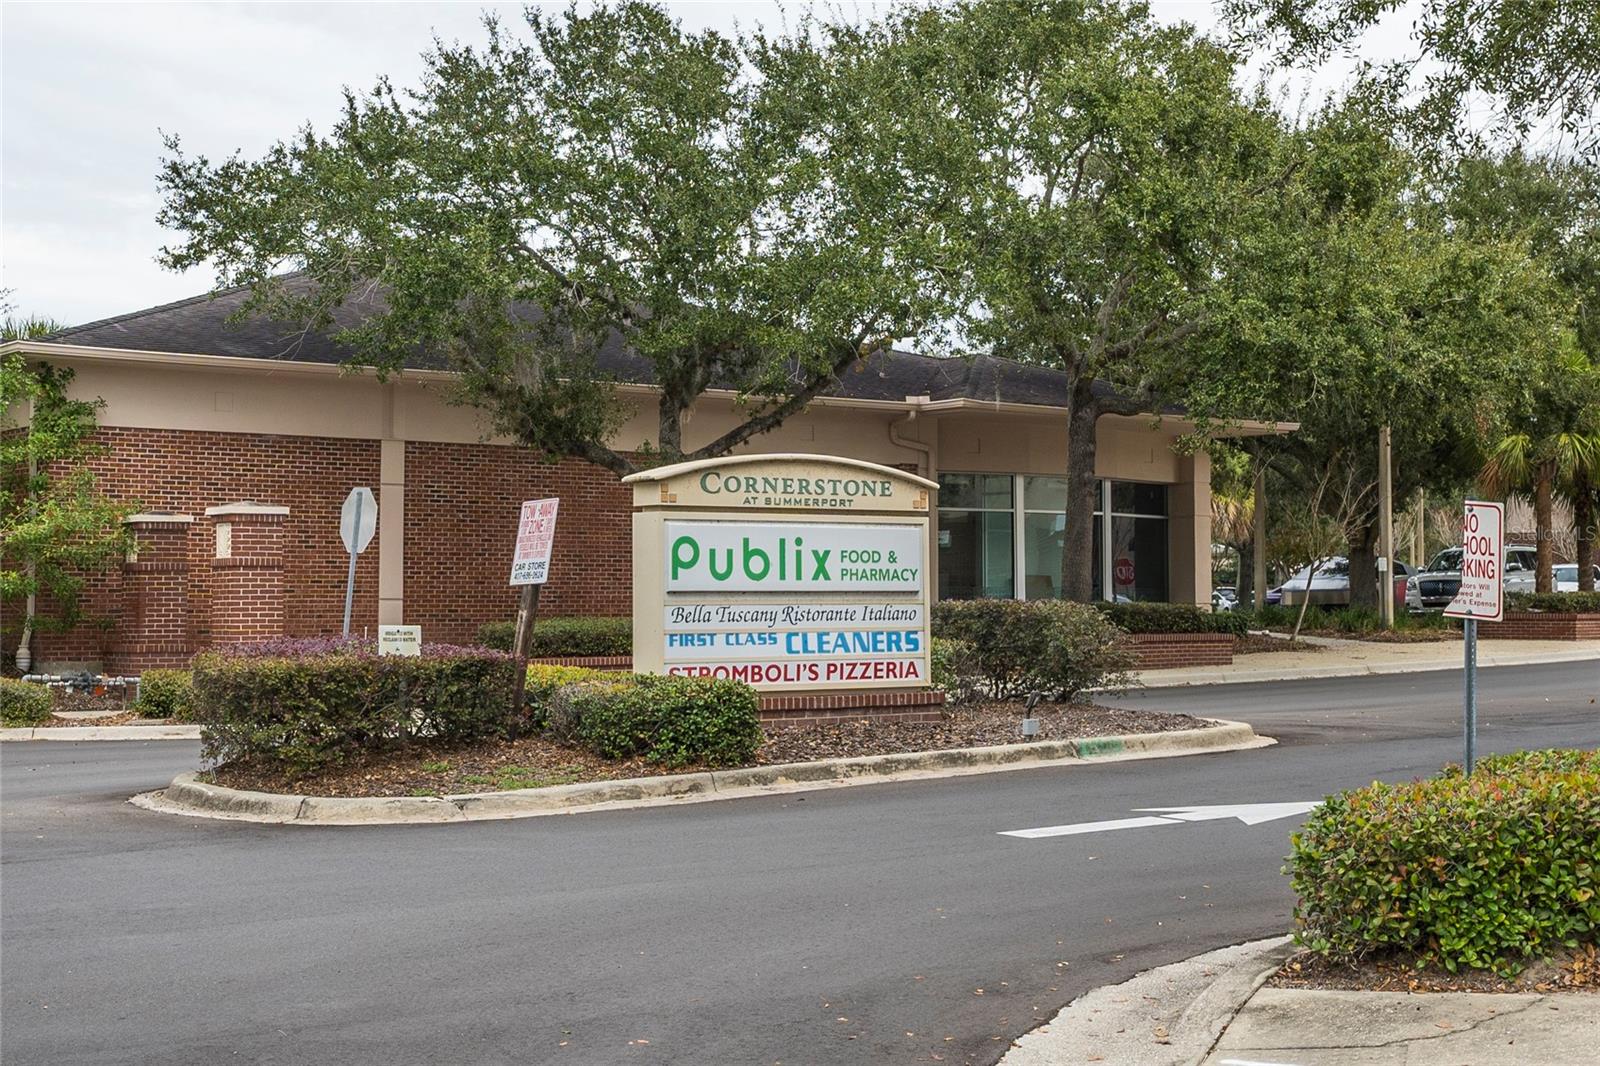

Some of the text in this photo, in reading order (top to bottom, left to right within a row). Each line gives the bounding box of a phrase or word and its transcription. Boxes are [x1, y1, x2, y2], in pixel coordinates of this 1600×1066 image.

[700, 472, 892, 497] CORNERSTONE
[743, 497, 854, 508] AT SUMMERPORT
[671, 535, 832, 582] Publix
[840, 550, 898, 564] FOOD &
[515, 561, 546, 571] CAR STORE
[840, 568, 918, 582] PHARMACY
[1469, 599, 1496, 607] Expense
[671, 605, 917, 628] Bella Tuscany Ristorante Italiano
[669, 630, 920, 655] FIRST CLASS CLEANERS
[826, 661, 919, 681] PIZZERIA
